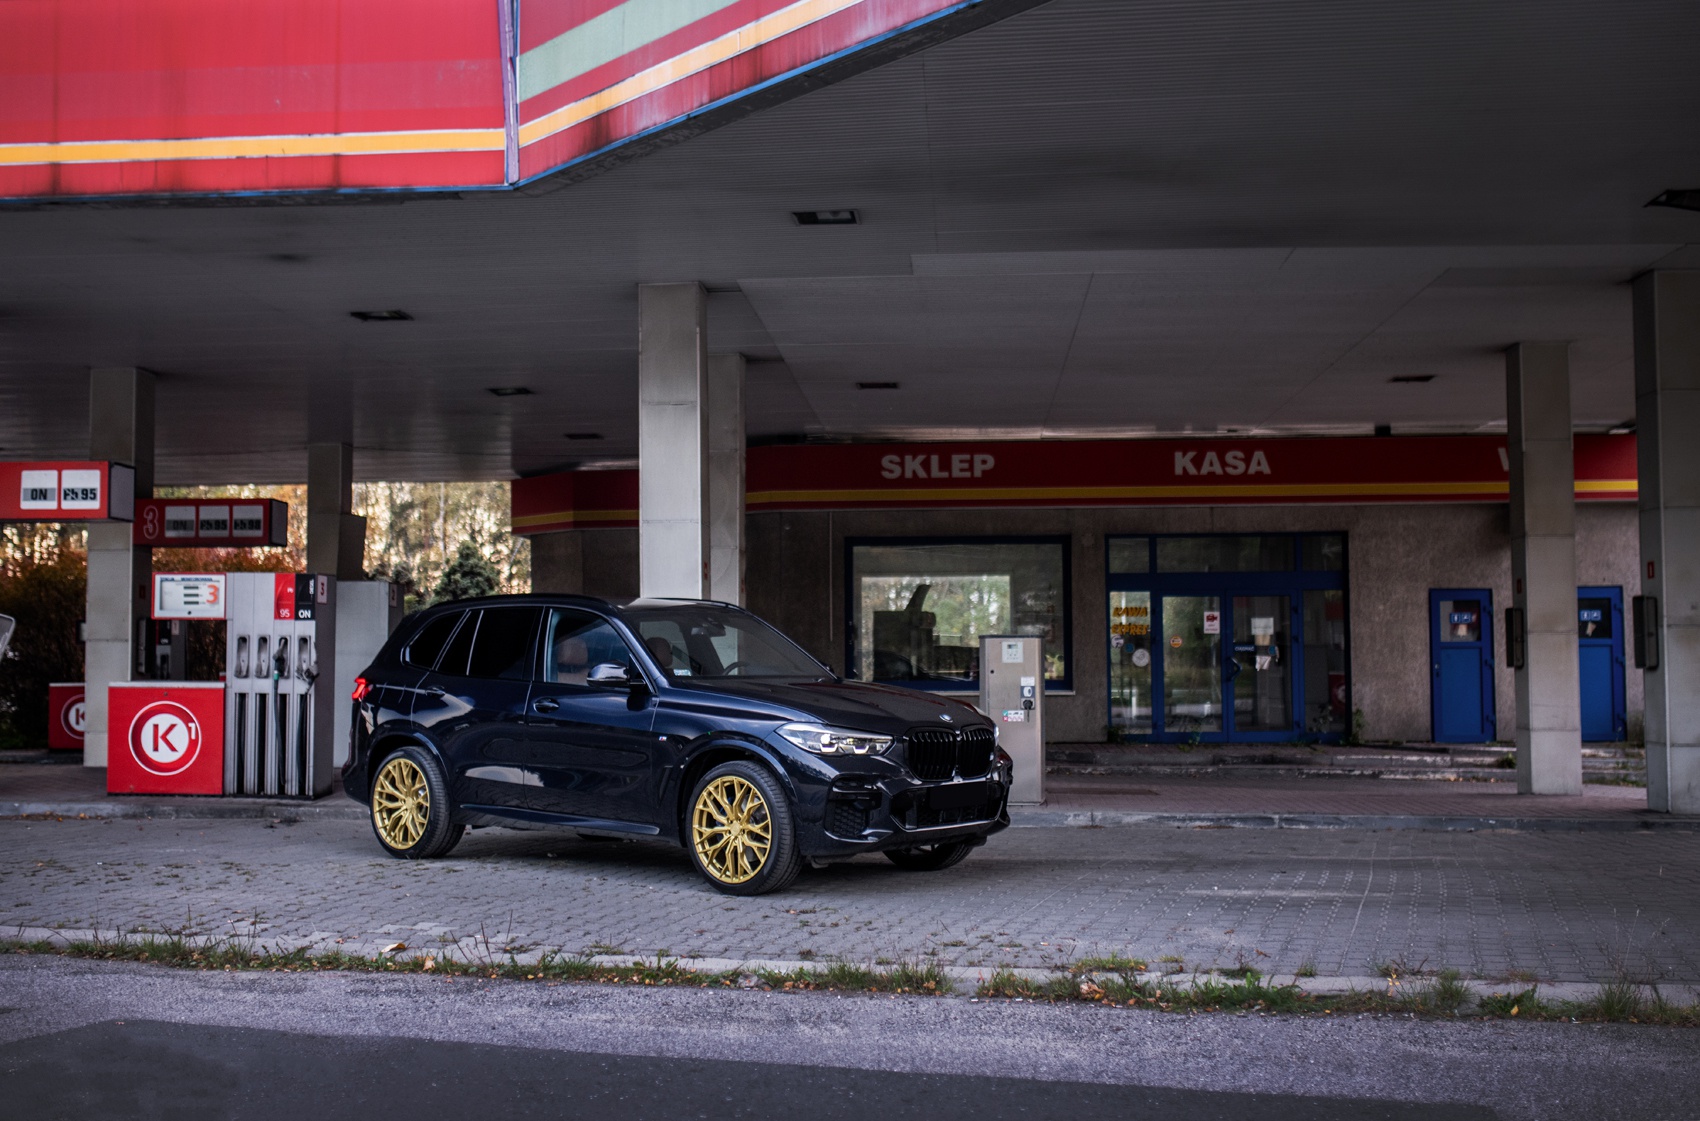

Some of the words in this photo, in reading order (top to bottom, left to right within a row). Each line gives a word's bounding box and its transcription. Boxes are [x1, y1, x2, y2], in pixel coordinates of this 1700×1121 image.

[881, 454, 995, 479] SKLEP
[1174, 450, 1272, 476] KASA
[30, 488, 48, 501] ON
[81, 488, 97, 501] 95
[143, 505, 159, 540] 3
[172, 520, 187, 531] ON
[206, 584, 219, 604] 3
[320, 582, 325, 596] 3
[279, 609, 290, 618] 95
[298, 609, 312, 619] ON
[152, 723, 179, 753] K
